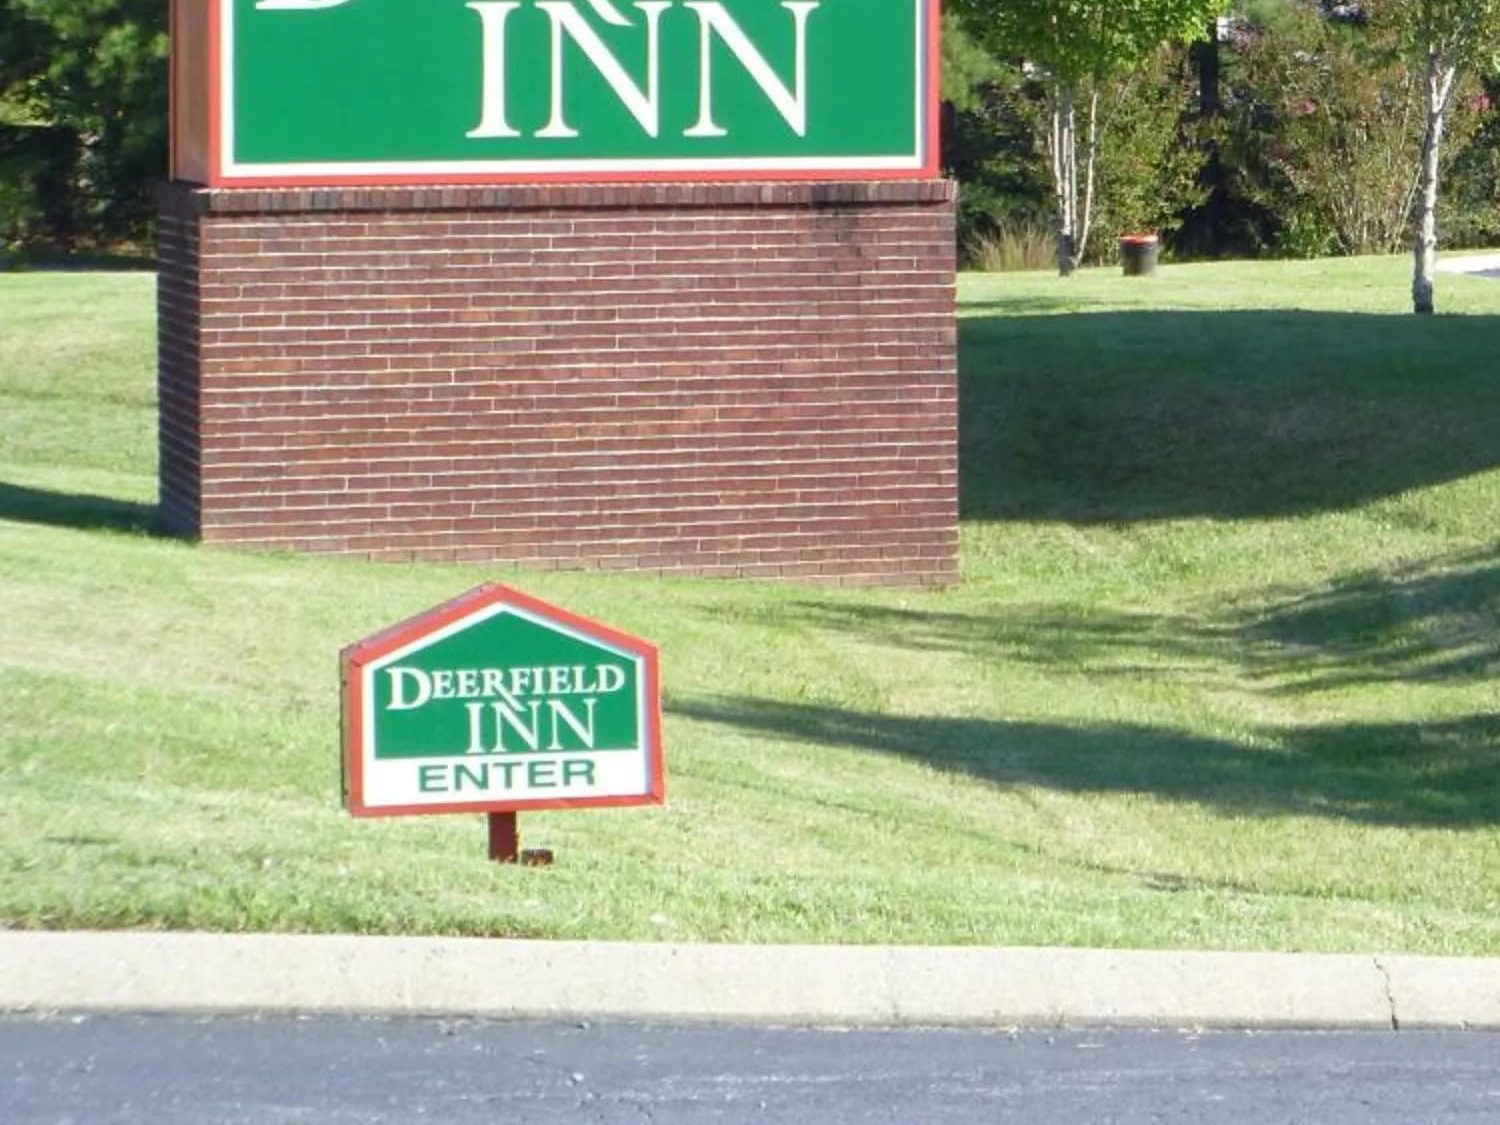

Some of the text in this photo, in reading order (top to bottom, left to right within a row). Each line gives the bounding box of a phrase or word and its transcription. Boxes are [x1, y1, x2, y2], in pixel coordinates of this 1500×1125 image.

[465, 0, 820, 139] INN
[385, 663, 626, 712] DEERFIELD
[465, 698, 597, 754] INN
[417, 758, 597, 793] ENTER
